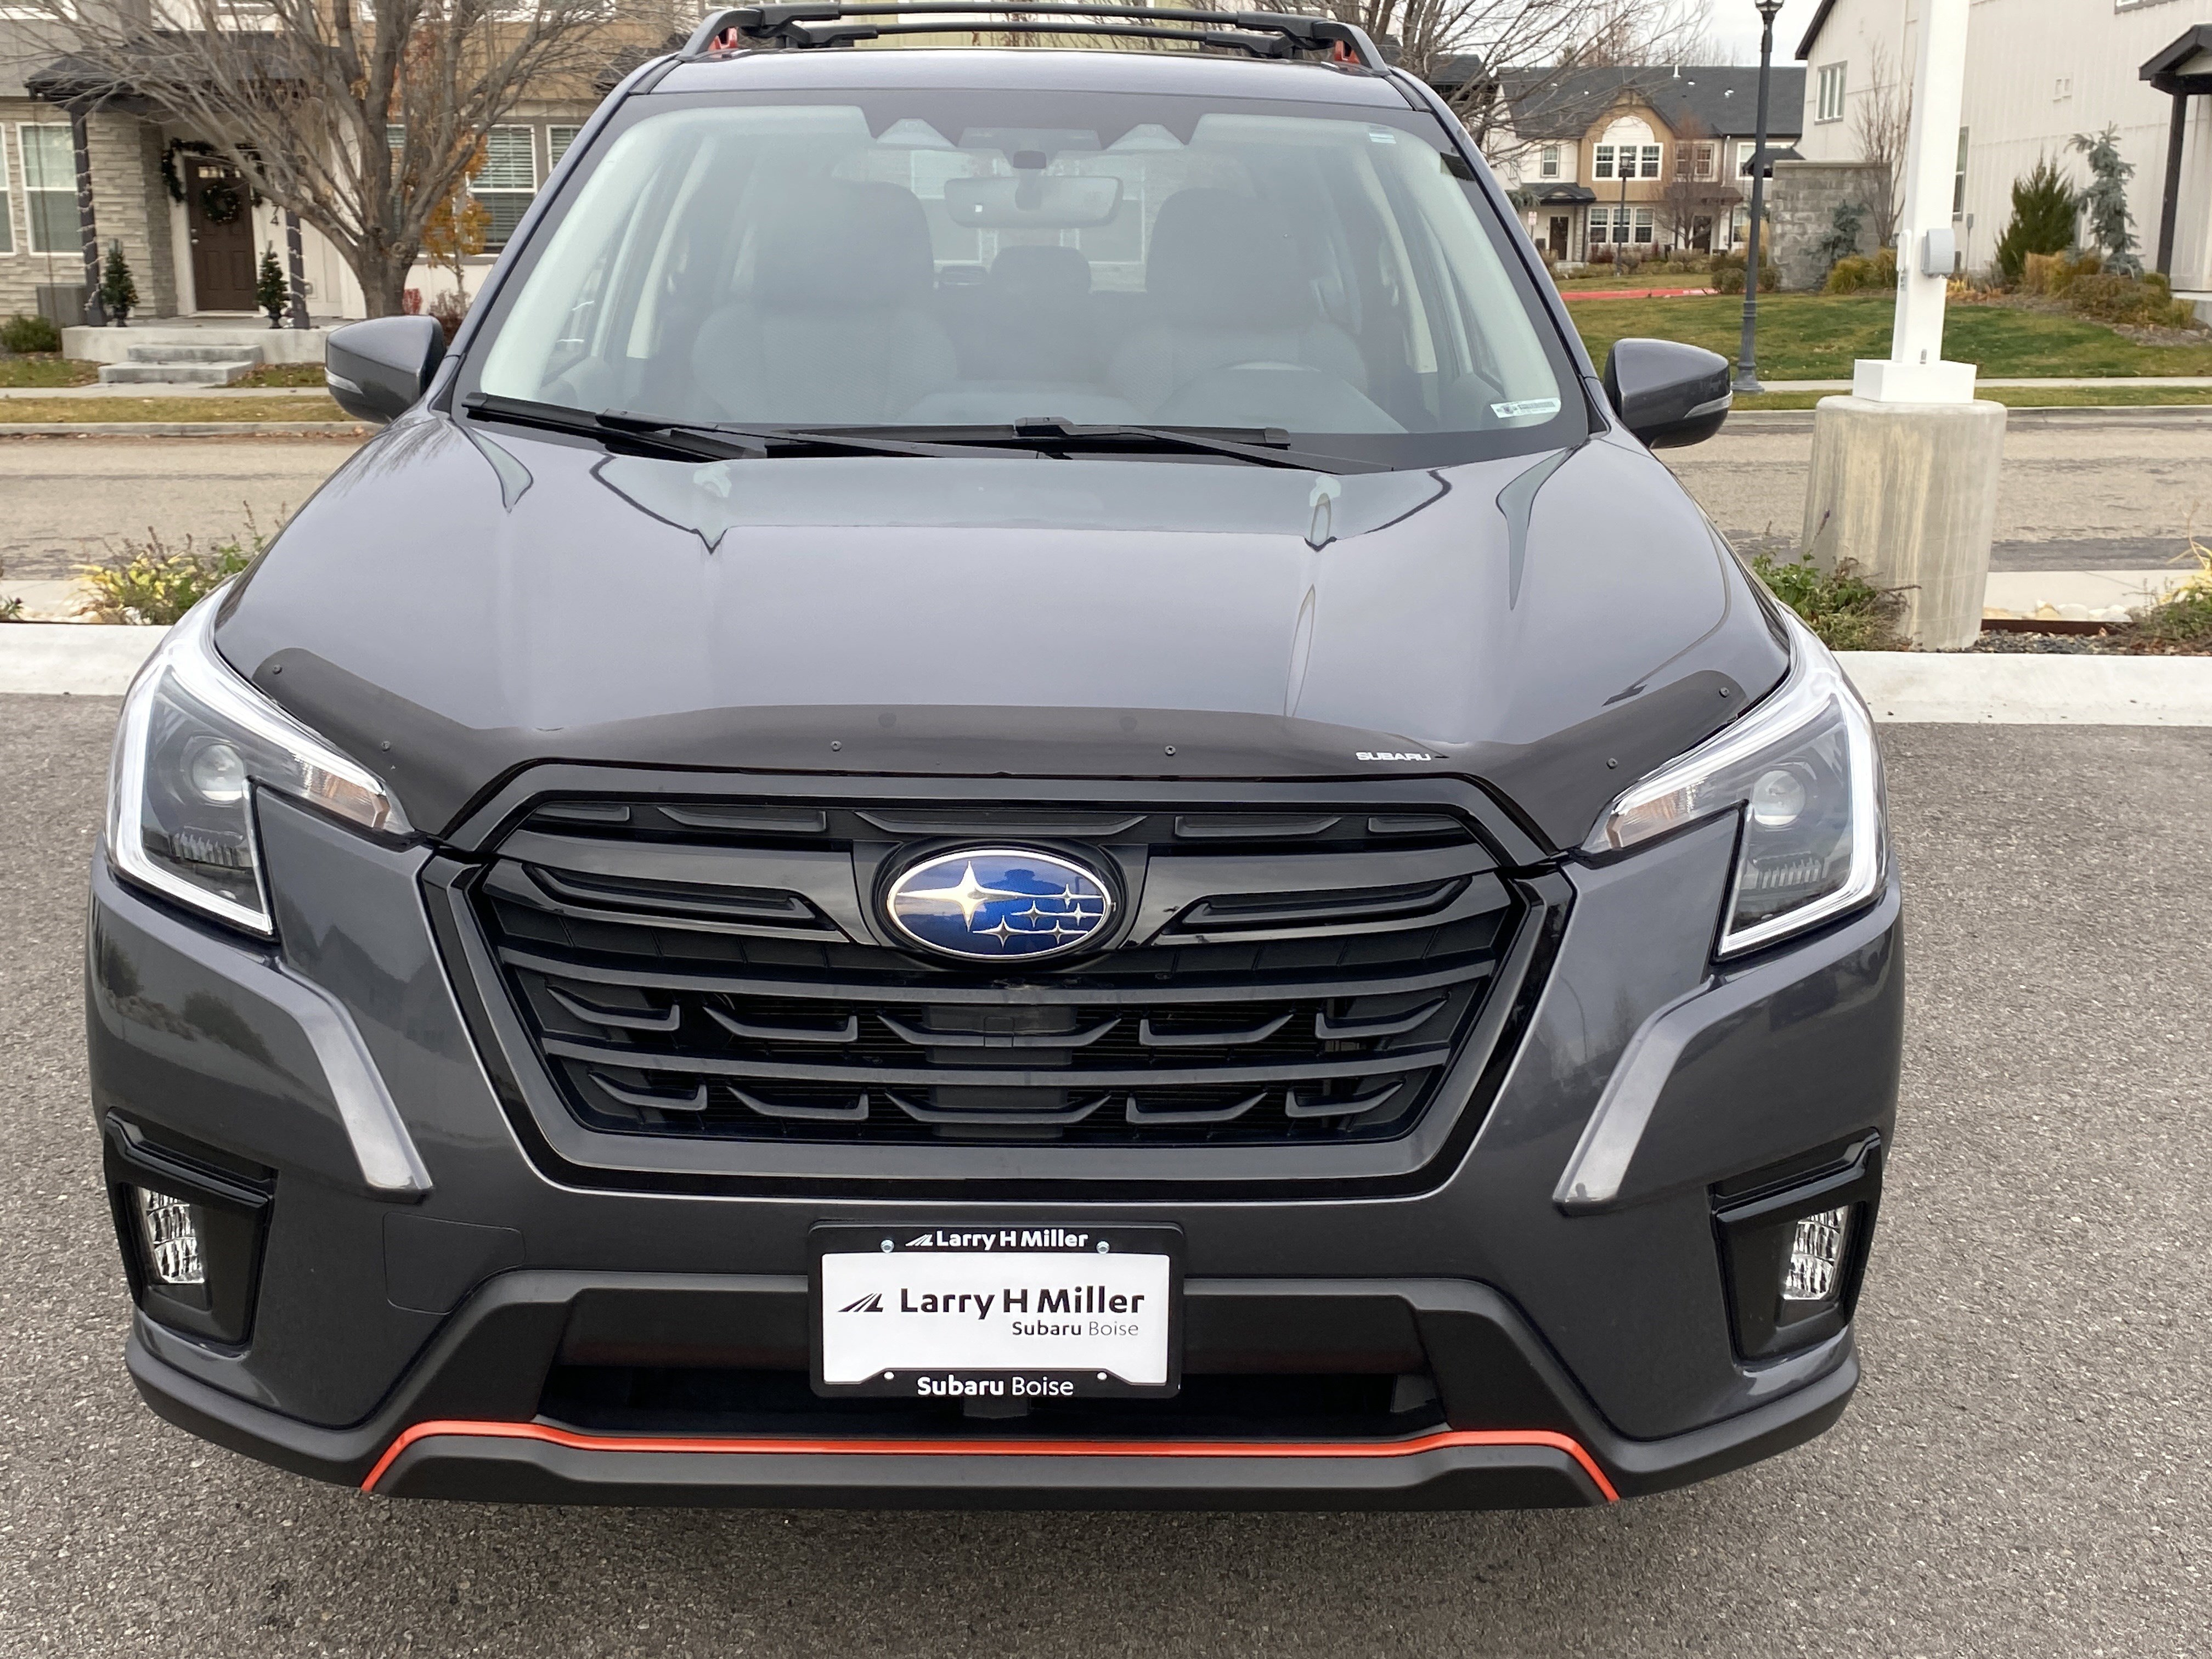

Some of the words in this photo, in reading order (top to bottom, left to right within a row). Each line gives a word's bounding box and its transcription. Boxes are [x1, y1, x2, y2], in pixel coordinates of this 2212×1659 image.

[1355, 752, 1431, 761] SUBARU
[936, 1231, 996, 1251] Larry
[1000, 1231, 1017, 1247] H
[1020, 1229, 1088, 1247] Miller
[901, 1288, 995, 1320] Larry
[1003, 1289, 1028, 1313] H
[1037, 1285, 1145, 1313] Miller
[1012, 1319, 1082, 1336] Subaru
[1088, 1321, 1138, 1336] Boise
[917, 1374, 1004, 1396] Subaru
[1012, 1376, 1074, 1396] Boise
